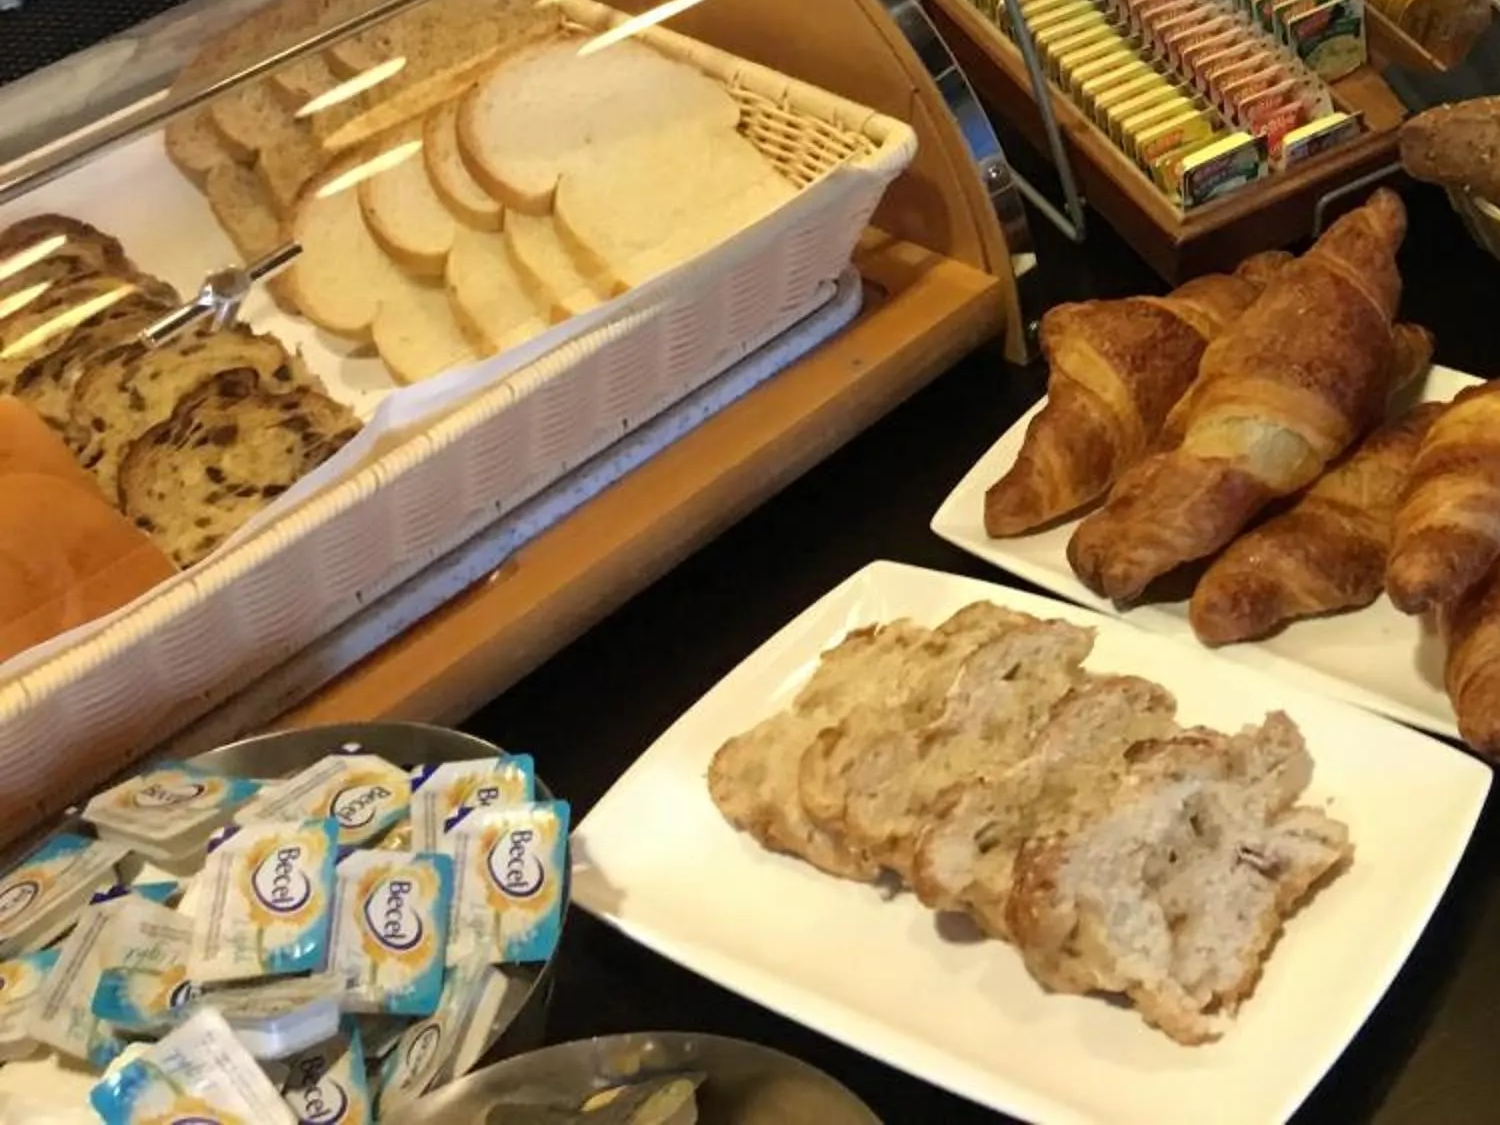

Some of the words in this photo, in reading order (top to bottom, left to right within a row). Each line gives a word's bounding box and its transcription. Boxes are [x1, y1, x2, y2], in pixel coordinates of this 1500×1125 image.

[271, 846, 301, 906] Becel
[505, 829, 533, 889] Becel
[382, 880, 413, 940] Becel
